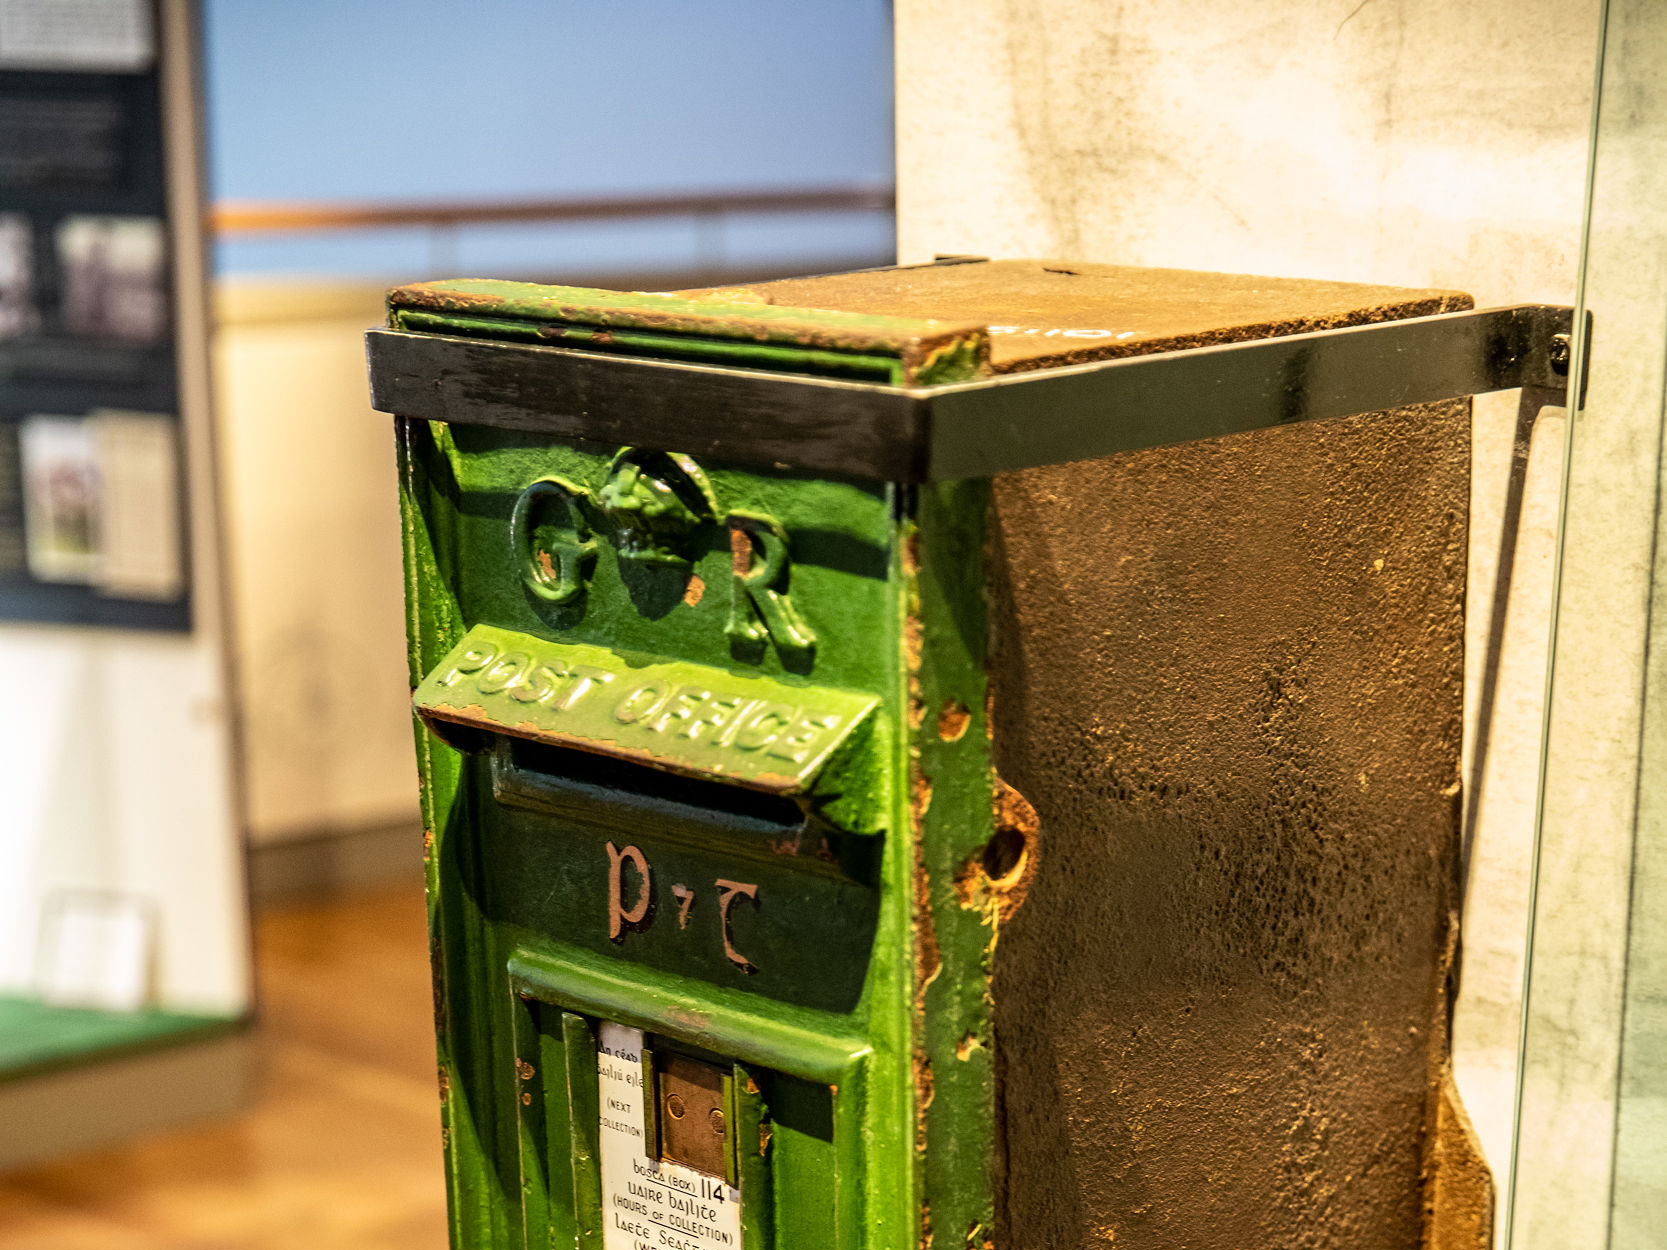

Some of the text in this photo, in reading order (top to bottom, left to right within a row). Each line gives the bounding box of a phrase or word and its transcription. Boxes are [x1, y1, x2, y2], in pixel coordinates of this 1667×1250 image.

[725, 507, 817, 647] R
[437, 640, 843, 764] POST OFFICE
[606, 1097, 632, 1113] (NEXT
[598, 1116, 643, 1138] COLLECTION)
[668, 1174, 696, 1193] (BOX)
[701, 1178, 726, 1204] 114
[613, 1193, 733, 1246] (HOURS OF COLLECTION)
